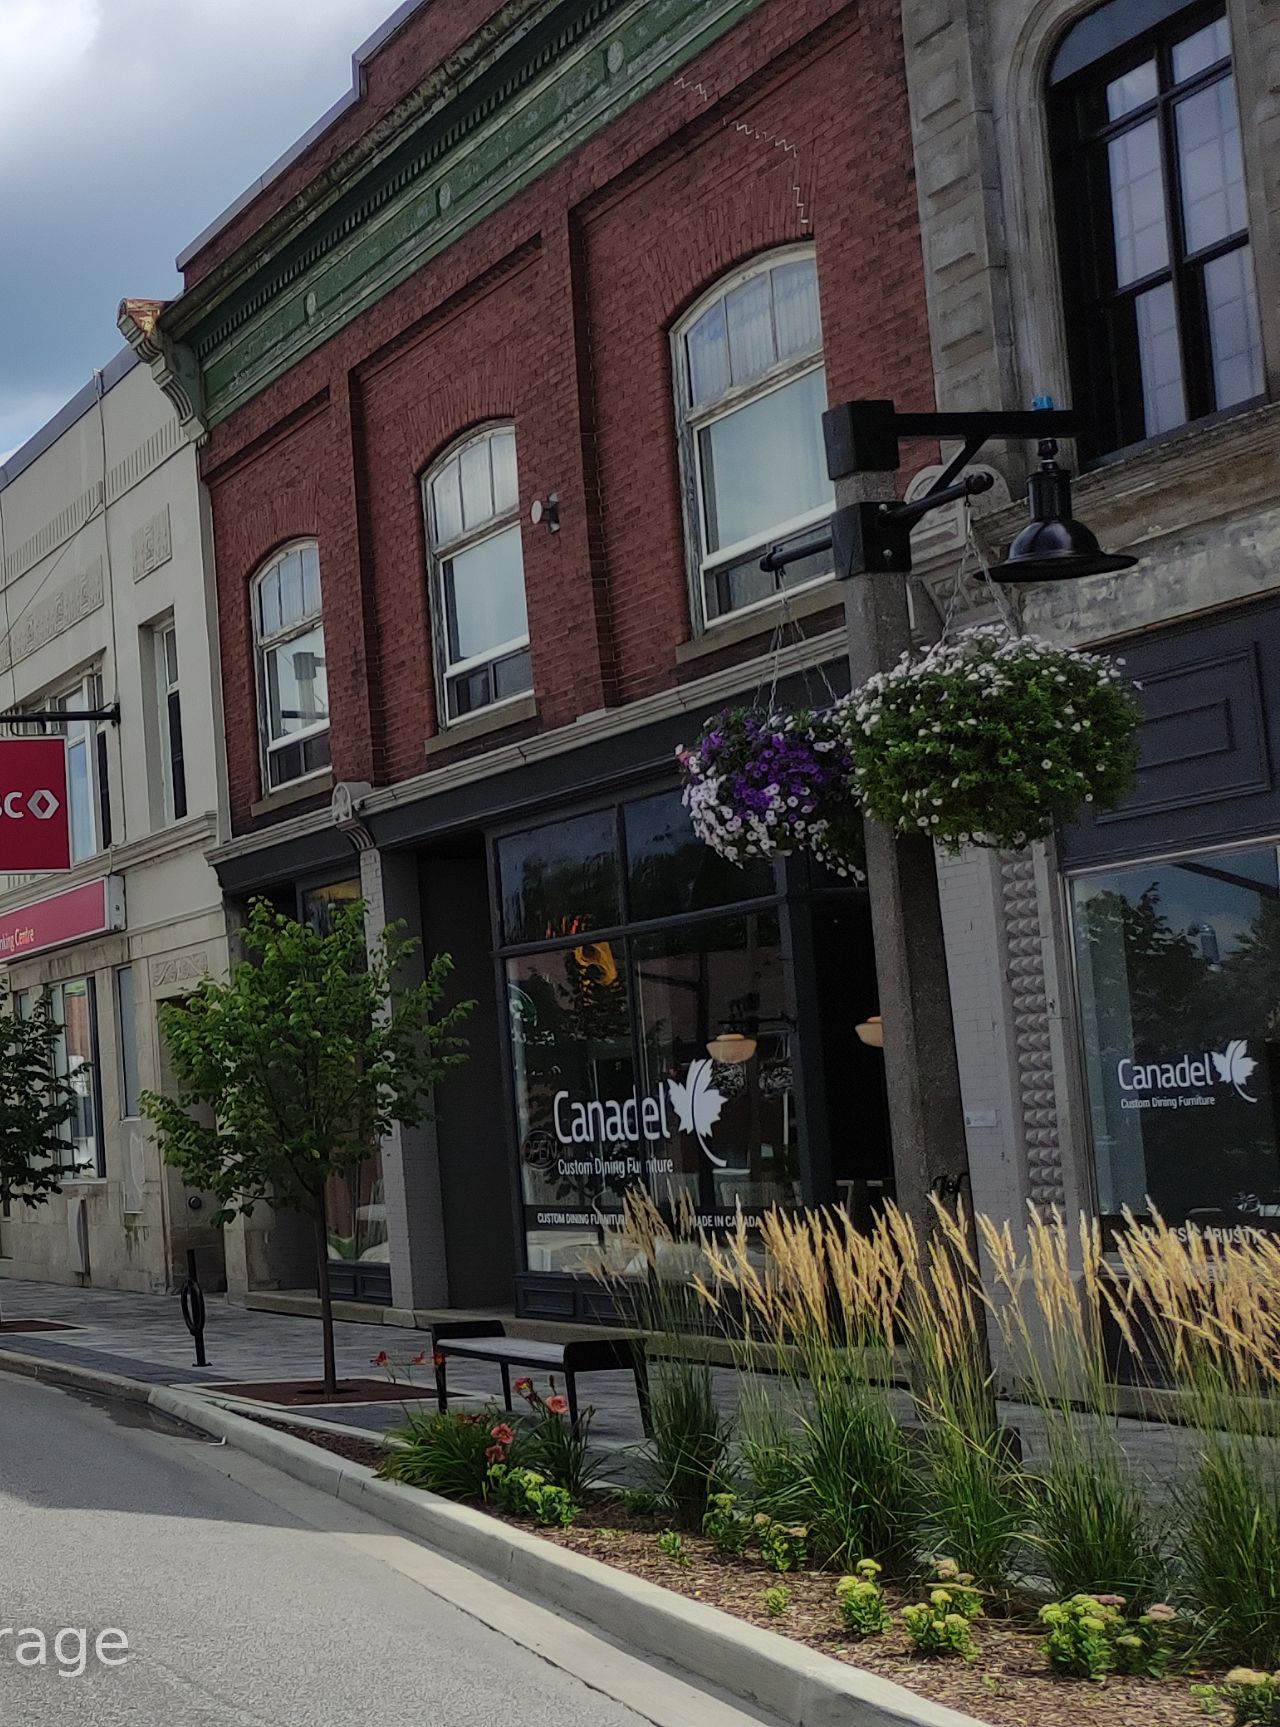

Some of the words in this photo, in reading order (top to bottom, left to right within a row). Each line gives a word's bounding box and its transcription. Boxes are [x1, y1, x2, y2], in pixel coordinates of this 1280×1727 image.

[15, 927, 35, 946] Centre
[1117, 1053, 1213, 1091] Canadel
[553, 1081, 671, 1144] Canadel
[1121, 1097, 1151, 1109] Custom
[1152, 1097, 1177, 1110] Dining
[1178, 1095, 1216, 1107] Furniture
[523, 1140, 557, 1161] OPEN
[558, 1159, 593, 1175] Custom
[595, 1156, 625, 1178] Dining
[537, 1213, 565, 1225] CUSTOM
[566, 1213, 589, 1225] DINING
[714, 1215, 724, 1227] IN
[725, 1215, 762, 1228] CAADA
